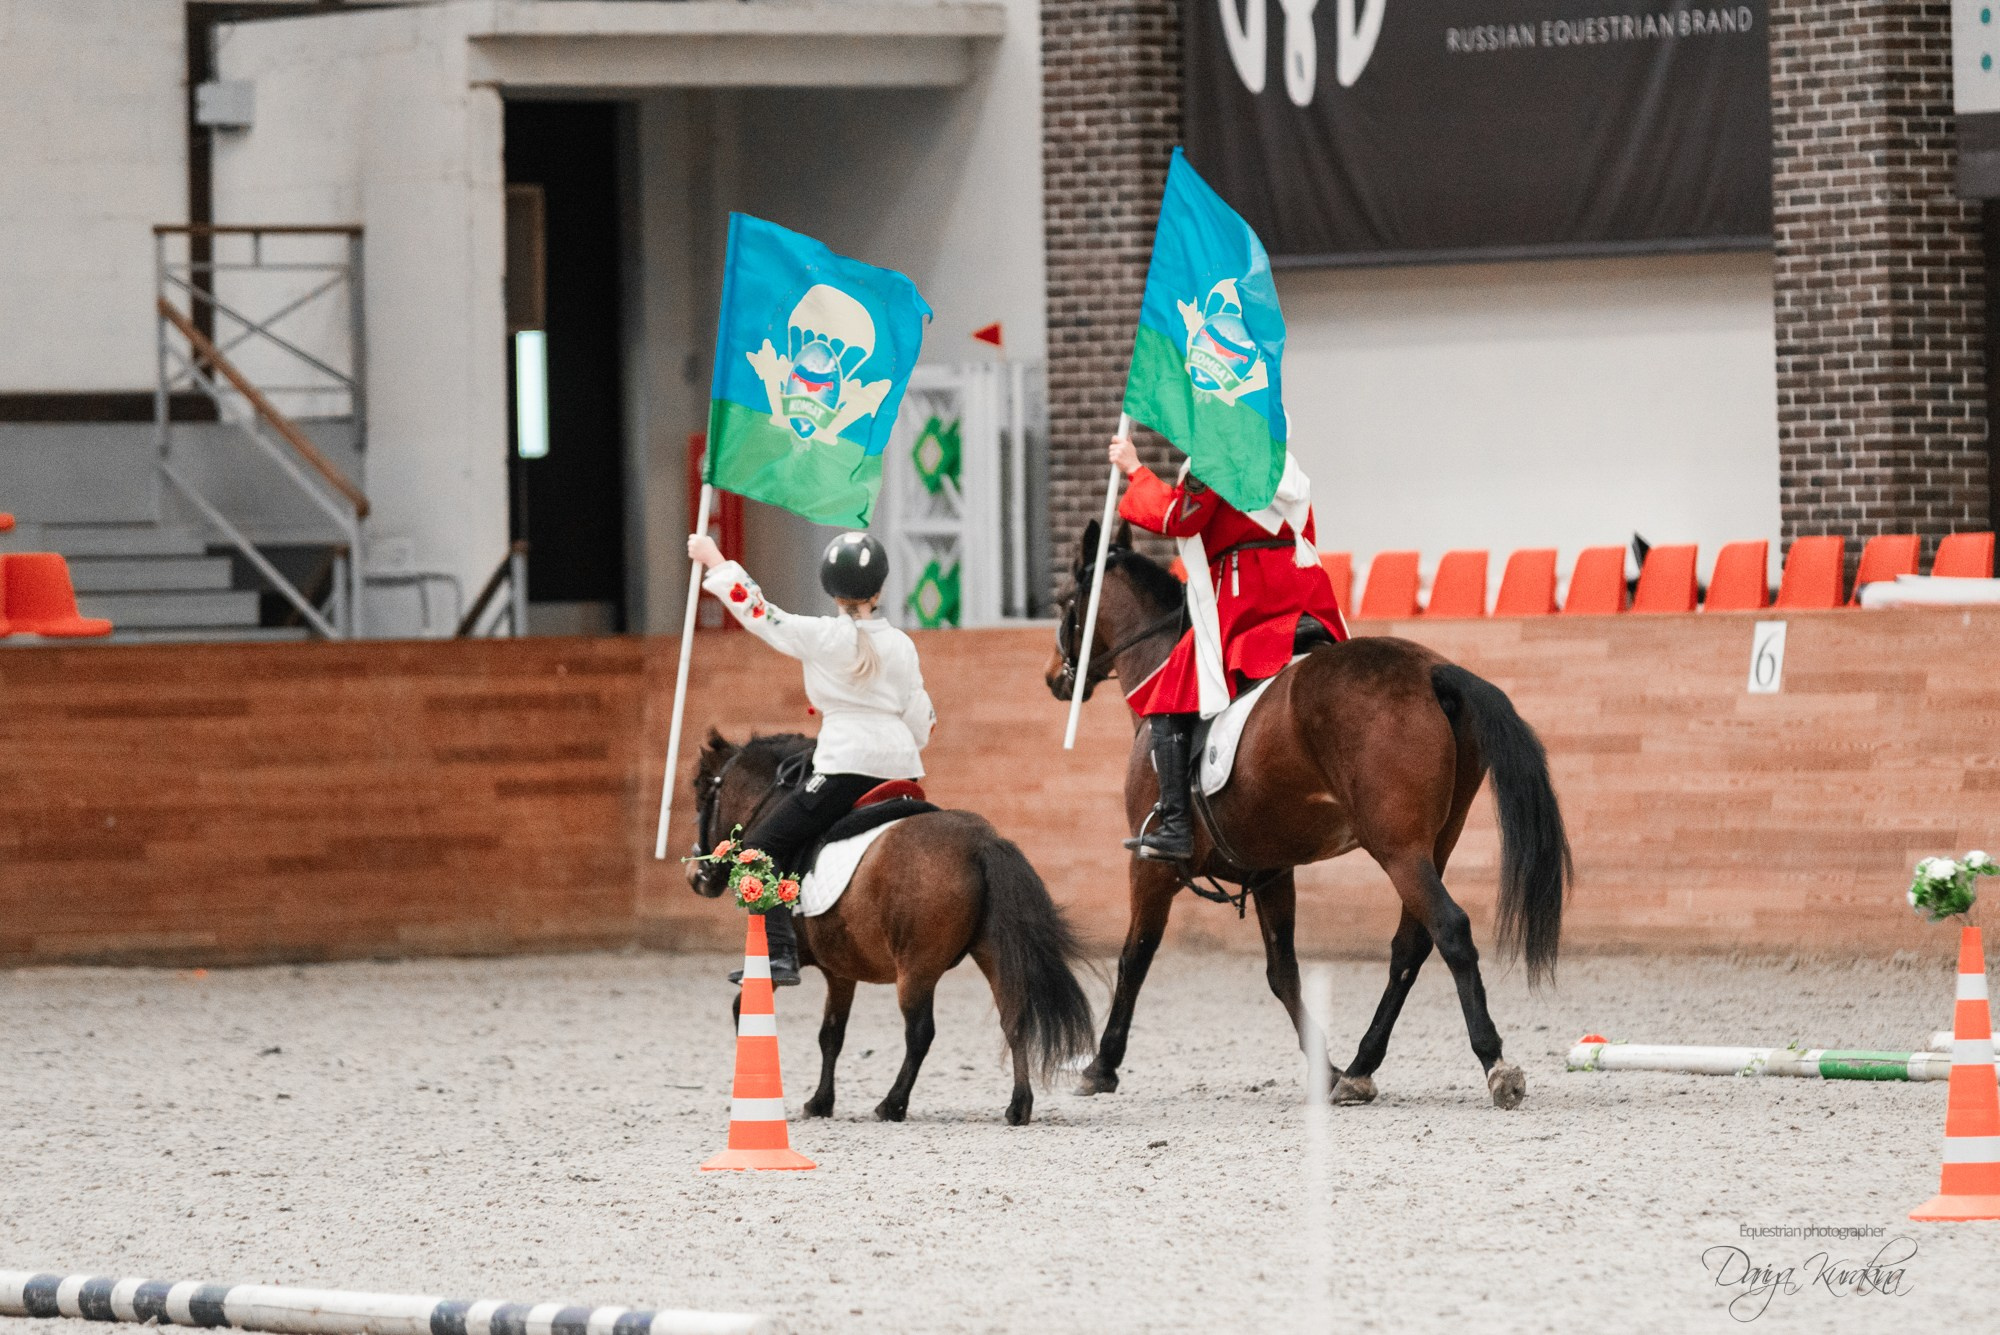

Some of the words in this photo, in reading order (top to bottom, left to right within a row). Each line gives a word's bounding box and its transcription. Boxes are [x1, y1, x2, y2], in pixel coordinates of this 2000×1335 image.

[1446, 23, 1536, 52] RUSSIAN
[1541, 13, 1676, 47] EQUESTRIAN
[1677, 6, 1753, 37] BRAND
[1755, 630, 1781, 687] 6
